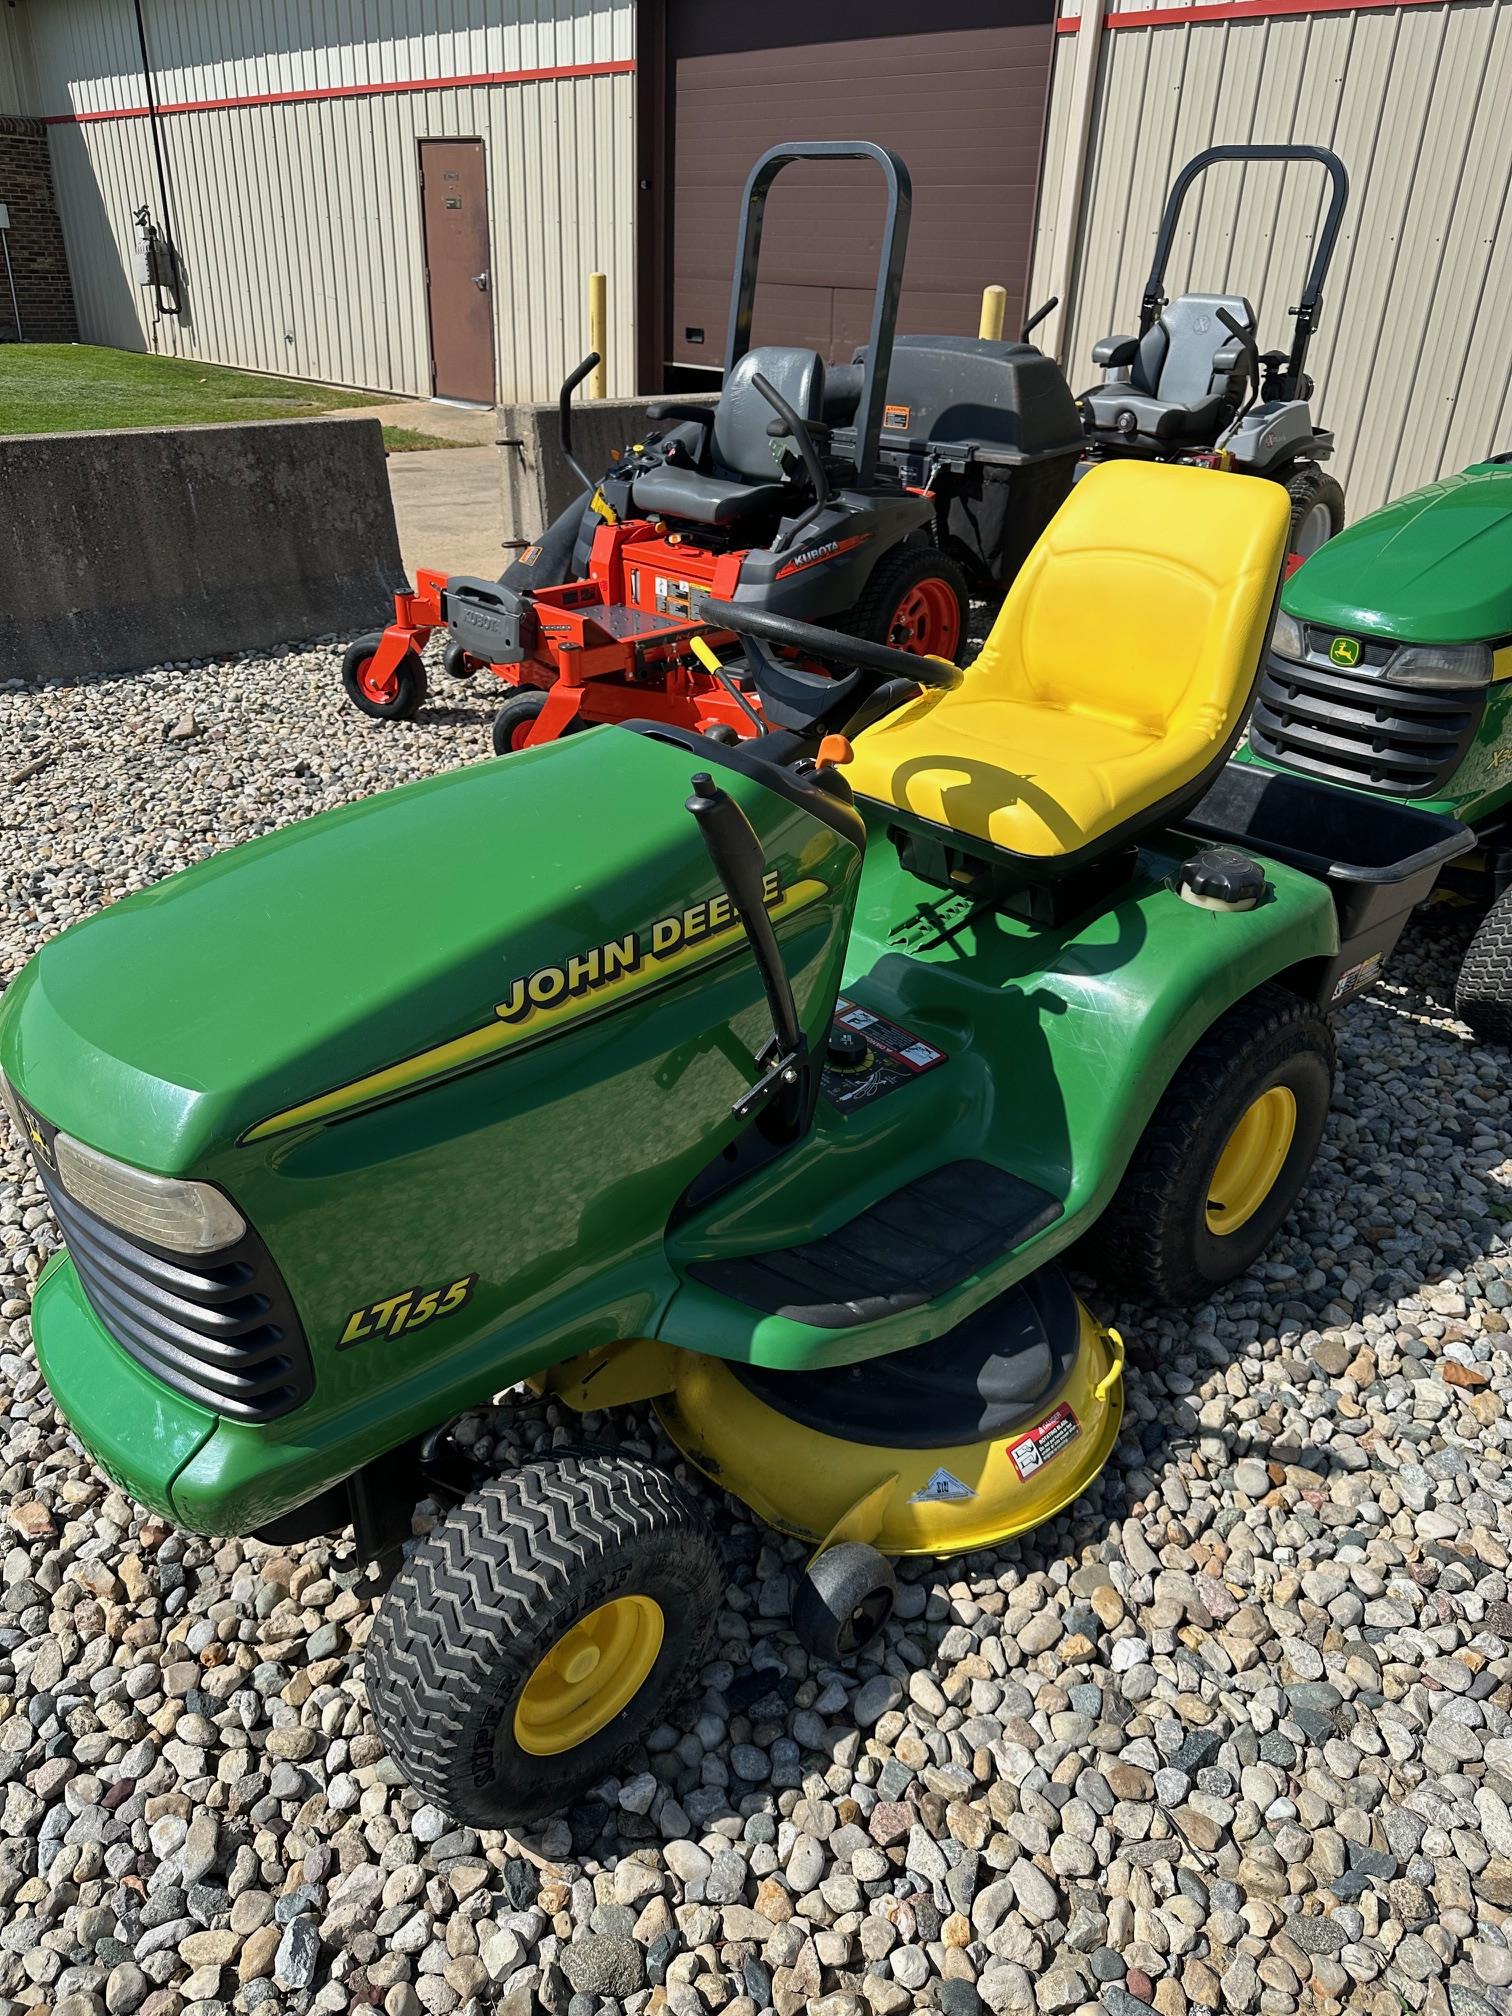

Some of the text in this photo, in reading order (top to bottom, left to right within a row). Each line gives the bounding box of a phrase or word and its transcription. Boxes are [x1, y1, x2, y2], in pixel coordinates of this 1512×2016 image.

[794, 541, 838, 565] KUBOTA
[463, 608, 502, 633] KUBOT
[493, 869, 786, 1022] JOHN DEEE
[338, 1274, 475, 1347] LT155
[473, 1563, 632, 1788] SUPER TURF
